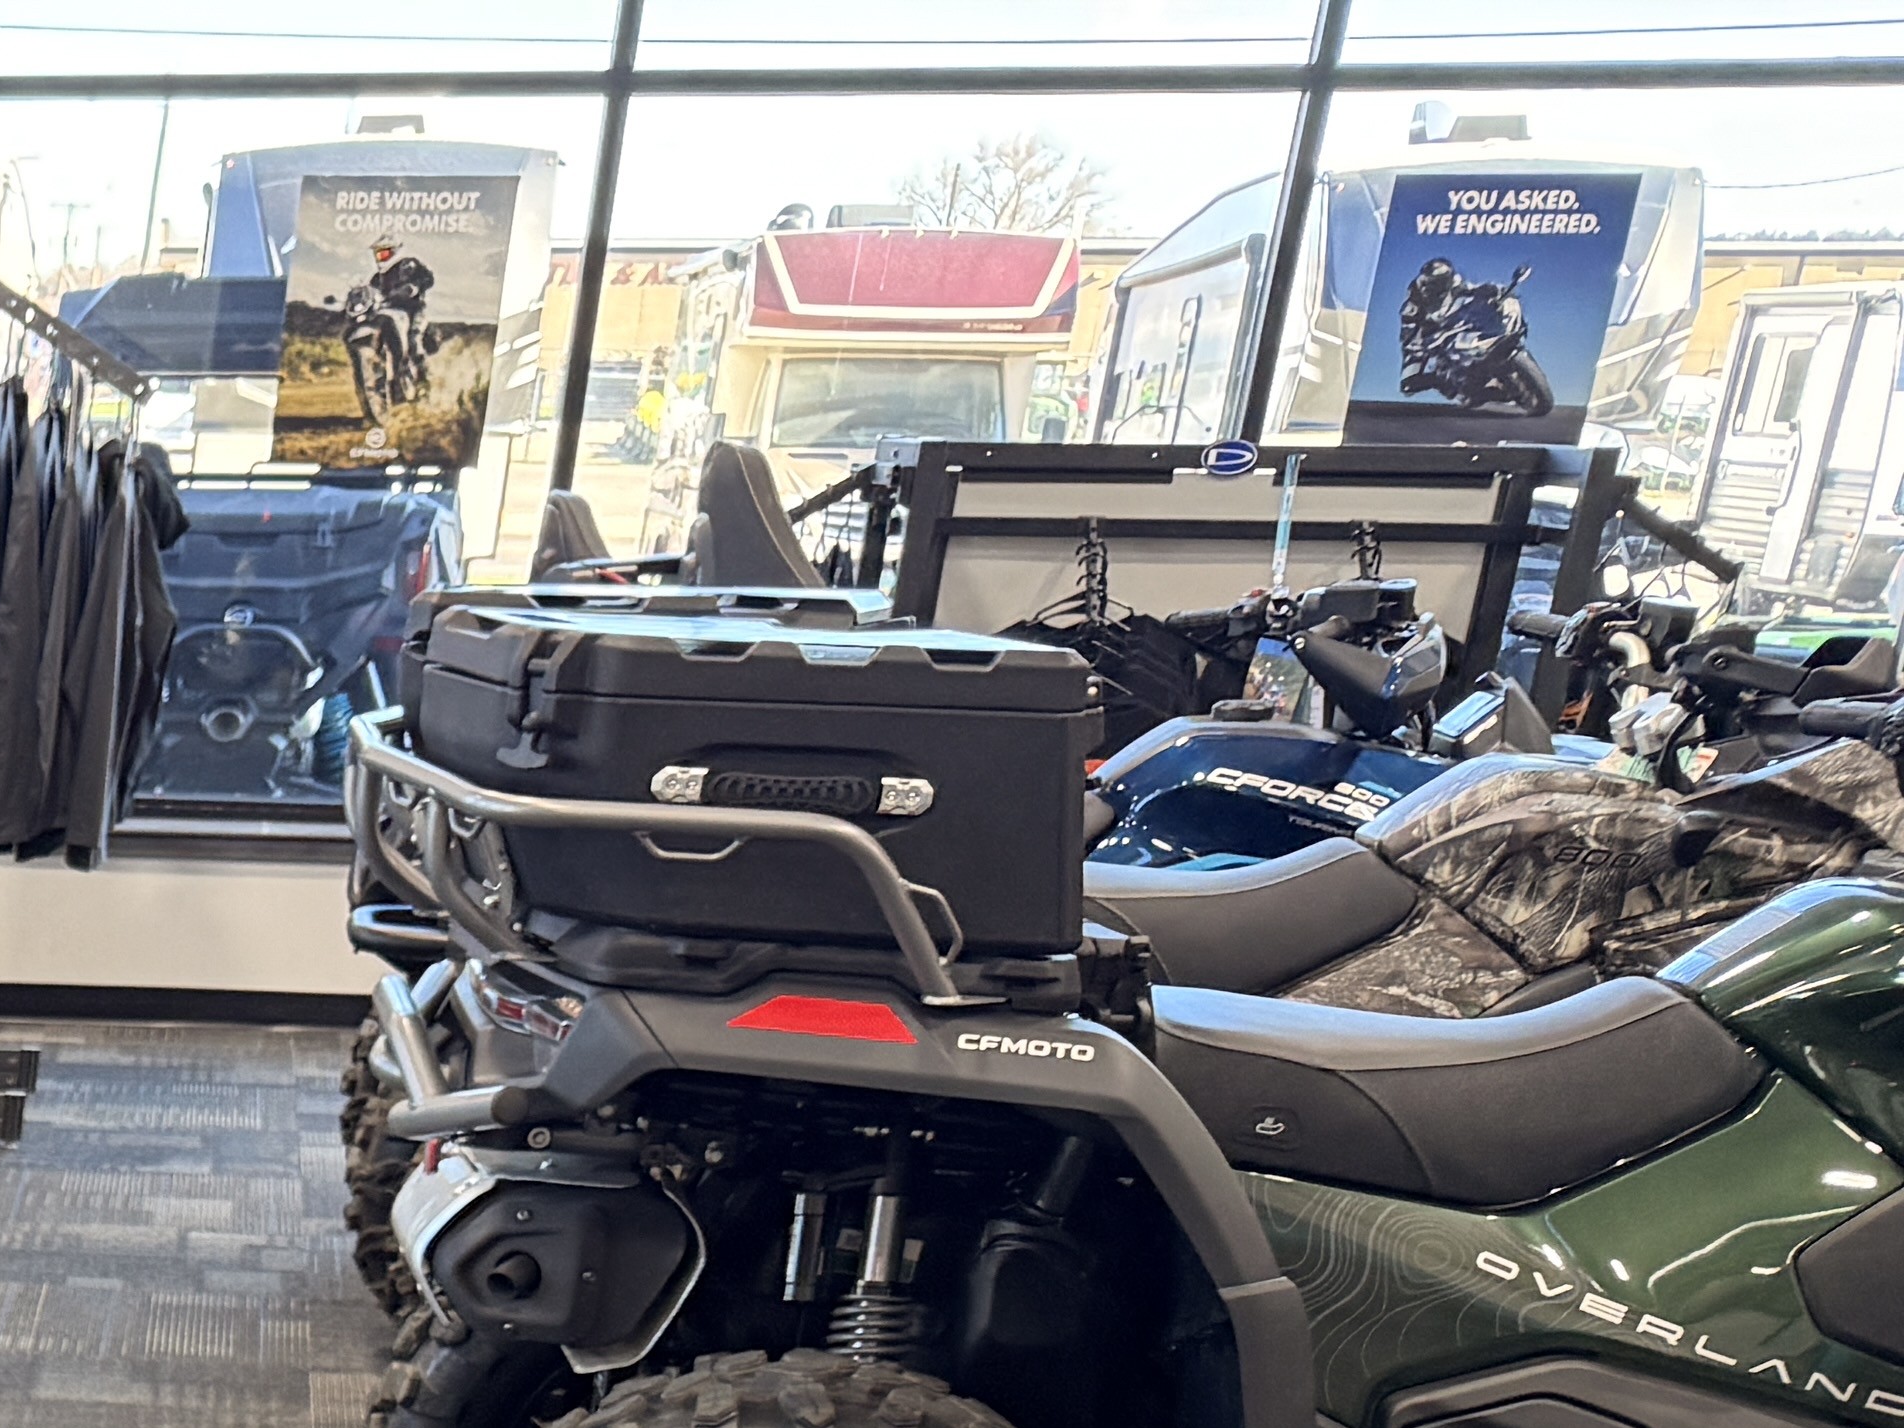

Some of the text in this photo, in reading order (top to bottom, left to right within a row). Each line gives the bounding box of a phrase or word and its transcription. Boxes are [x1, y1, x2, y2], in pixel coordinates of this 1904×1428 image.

[335, 190, 481, 211] RIDE WITHOUT
[1448, 189, 1580, 211] YOU ASKED.
[1416, 213, 1602, 235] WE ENGINEERED.
[1206, 766, 1379, 823] CFORCE
[957, 1032, 1096, 1062] CFMOTO
